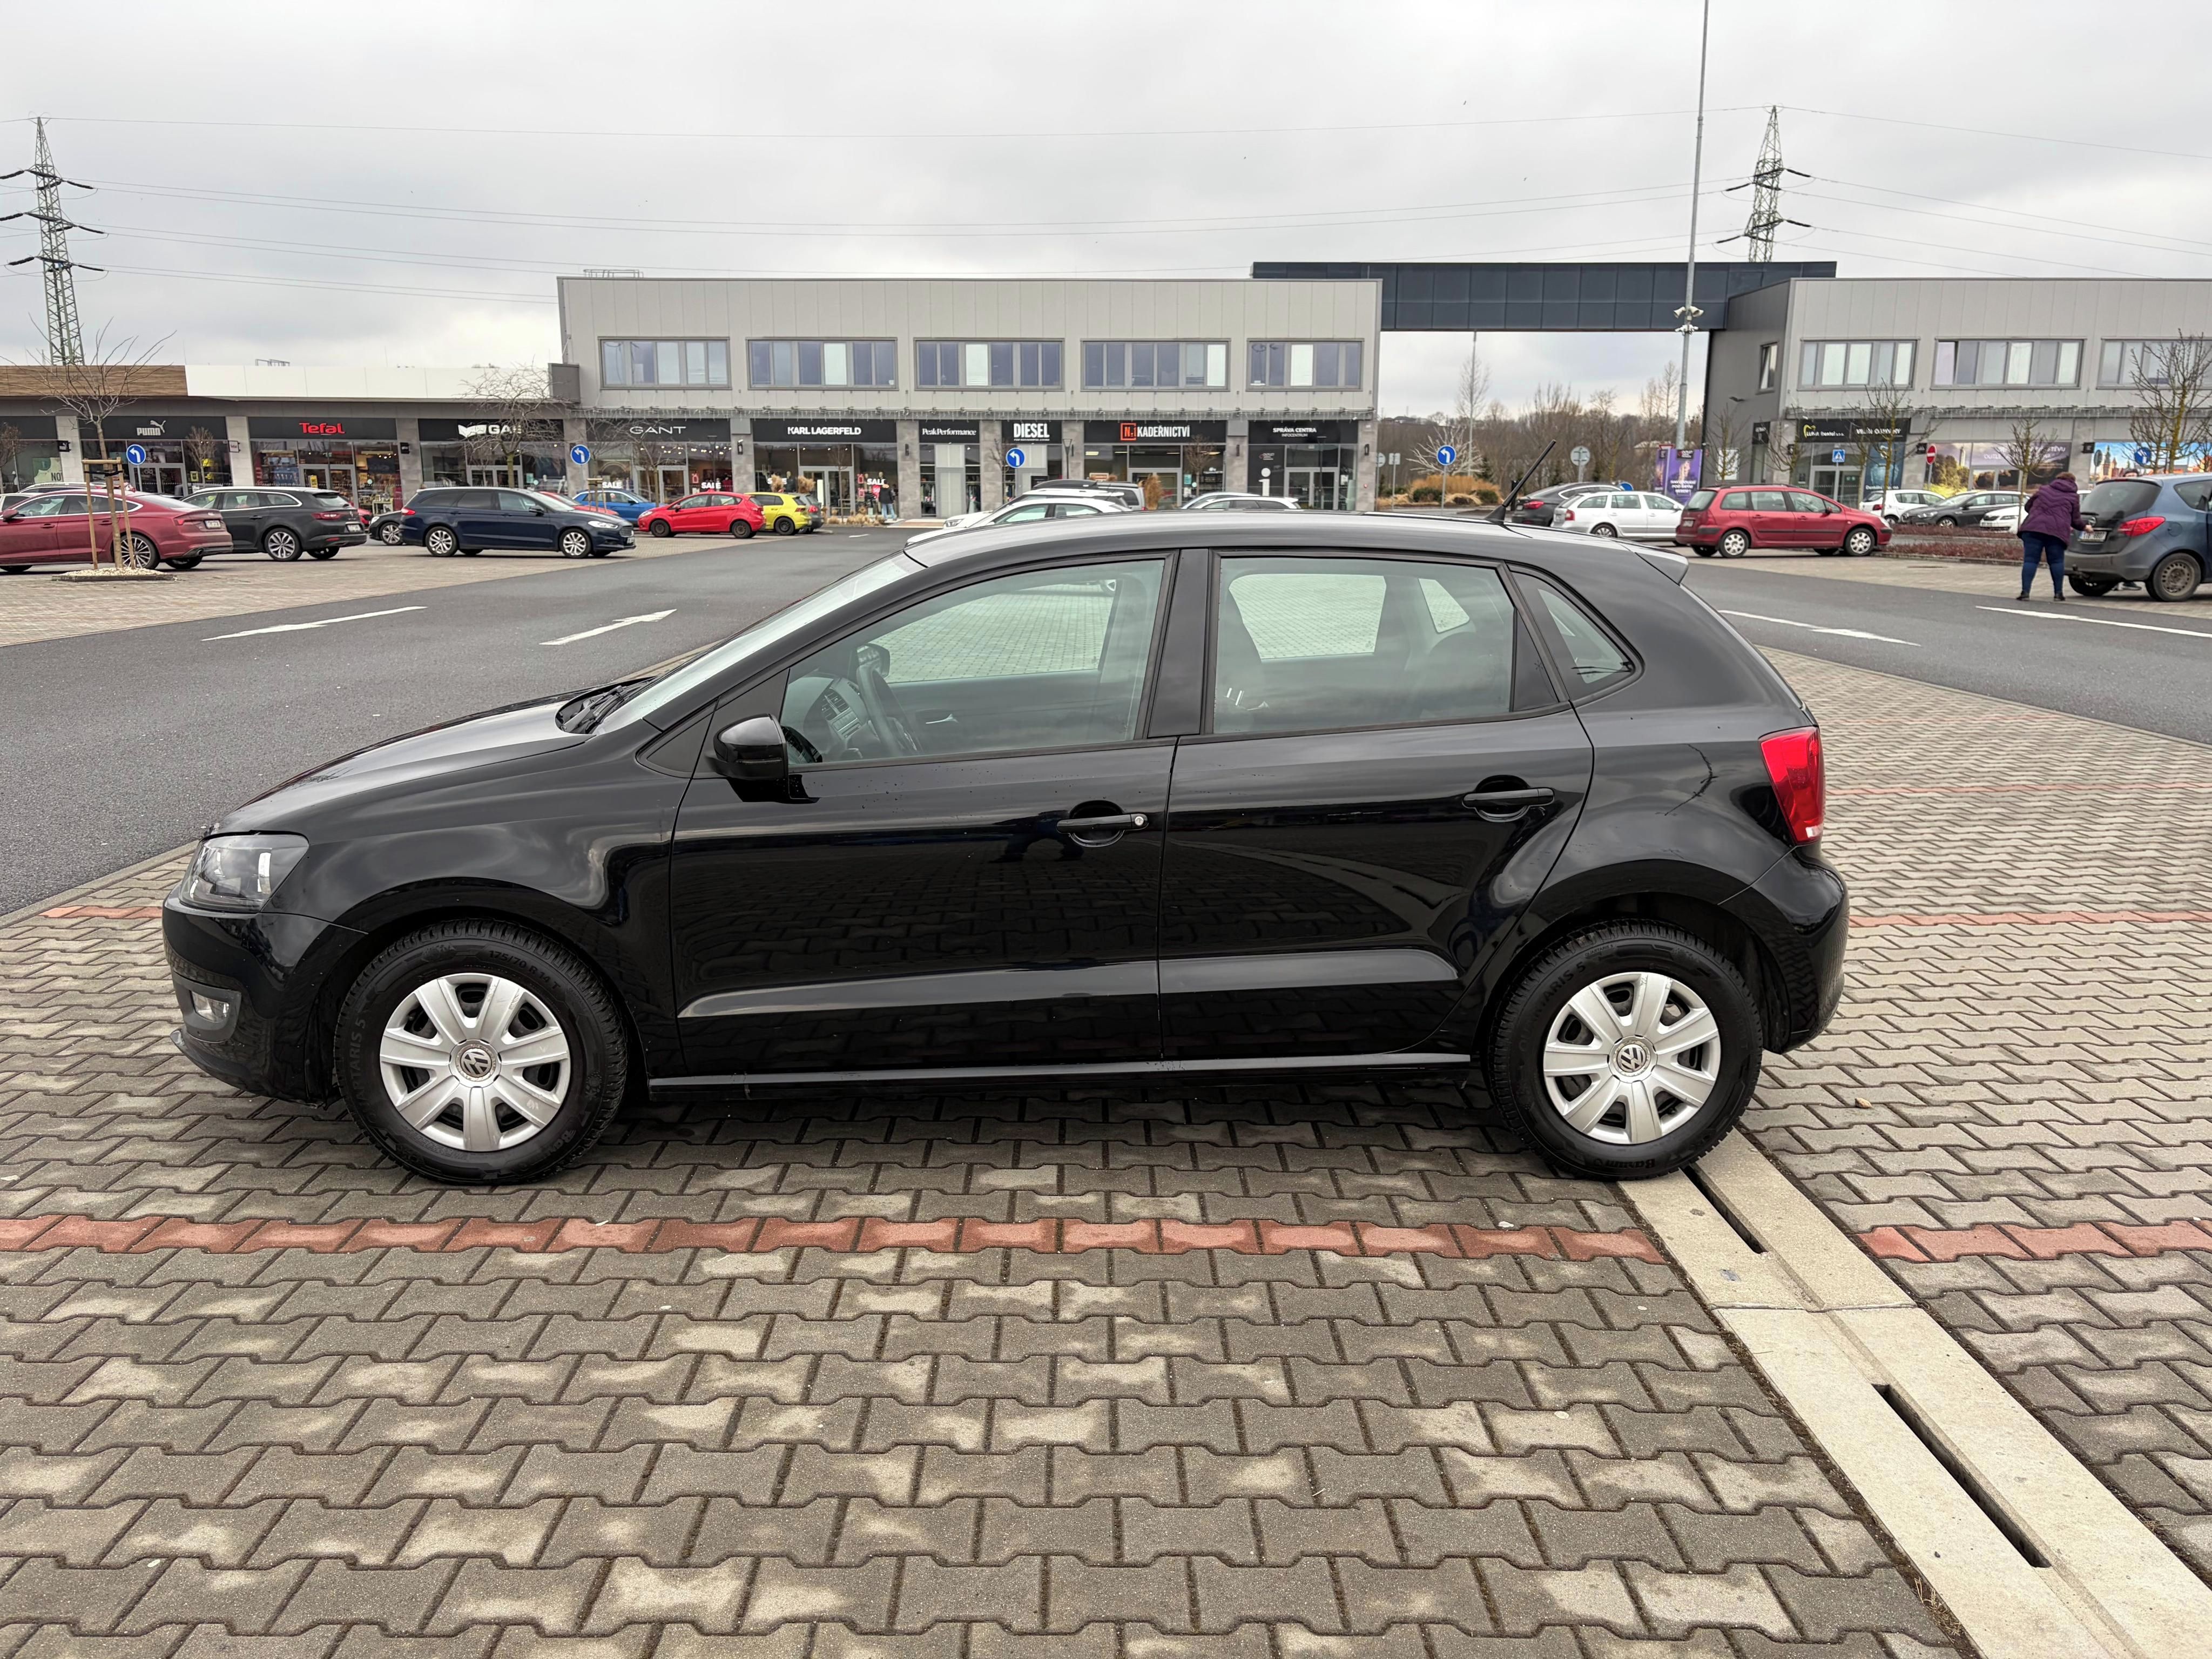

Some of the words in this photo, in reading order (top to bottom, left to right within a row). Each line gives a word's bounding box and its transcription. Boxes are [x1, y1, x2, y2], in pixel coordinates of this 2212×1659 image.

[136, 427, 161, 436] PUMA
[299, 423, 346, 435] Tefal
[629, 426, 686, 434] GANT
[787, 427, 811, 435] KARL
[811, 427, 861, 435] LAGERFELD
[1014, 423, 1050, 438] DIESEL
[1137, 425, 1190, 437] KADEŘNICTVÍ
[51, 472, 63, 481] NO
[489, 950, 527, 968] 175/70
[529, 966, 538, 974] R
[540, 972, 551, 983] 14
[552, 981, 561, 989] T
[1576, 961, 1586, 973] 5
[355, 1017, 366, 1029] 5
